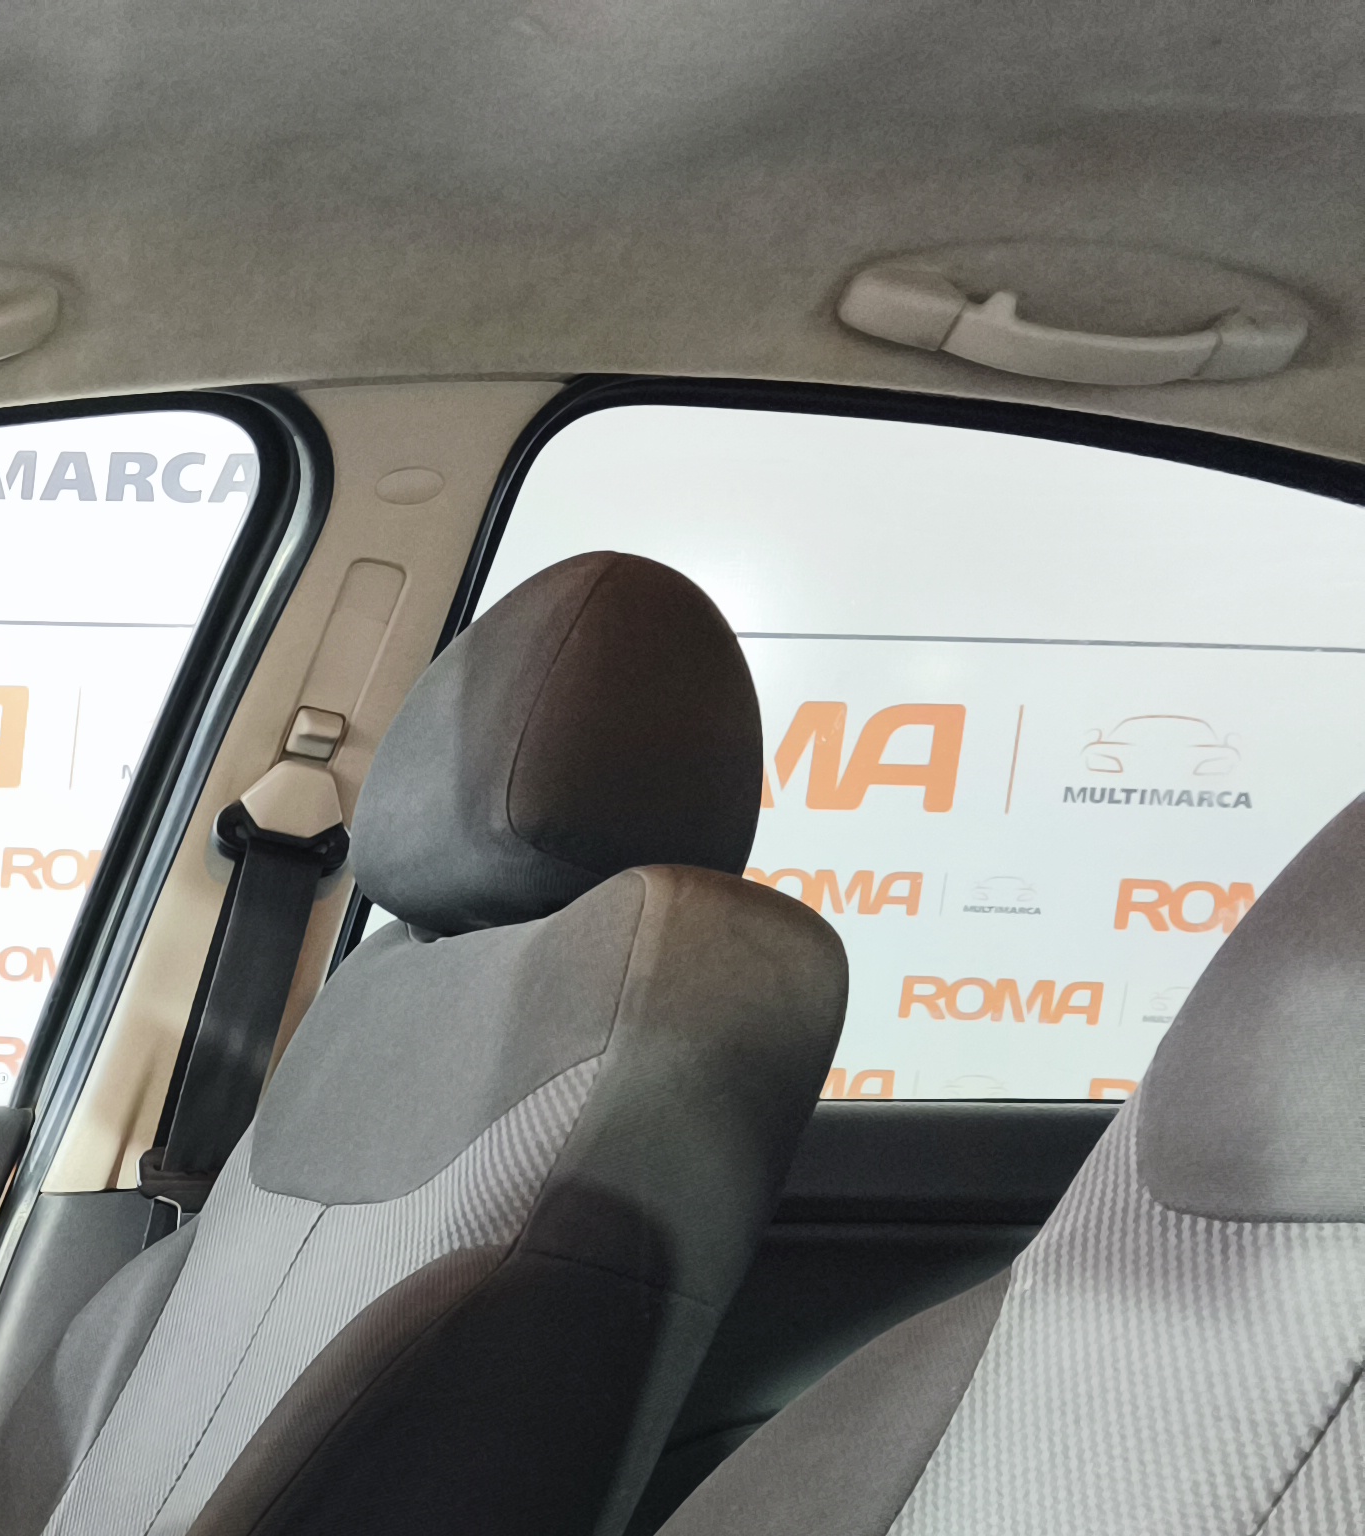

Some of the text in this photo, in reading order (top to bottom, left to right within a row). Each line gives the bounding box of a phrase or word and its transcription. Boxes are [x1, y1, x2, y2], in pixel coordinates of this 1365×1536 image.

[1062, 786, 1253, 809] MULTIMARCA
[962, 904, 1042, 915] MULTIMARCA
[898, 975, 1105, 1028] ROMA
